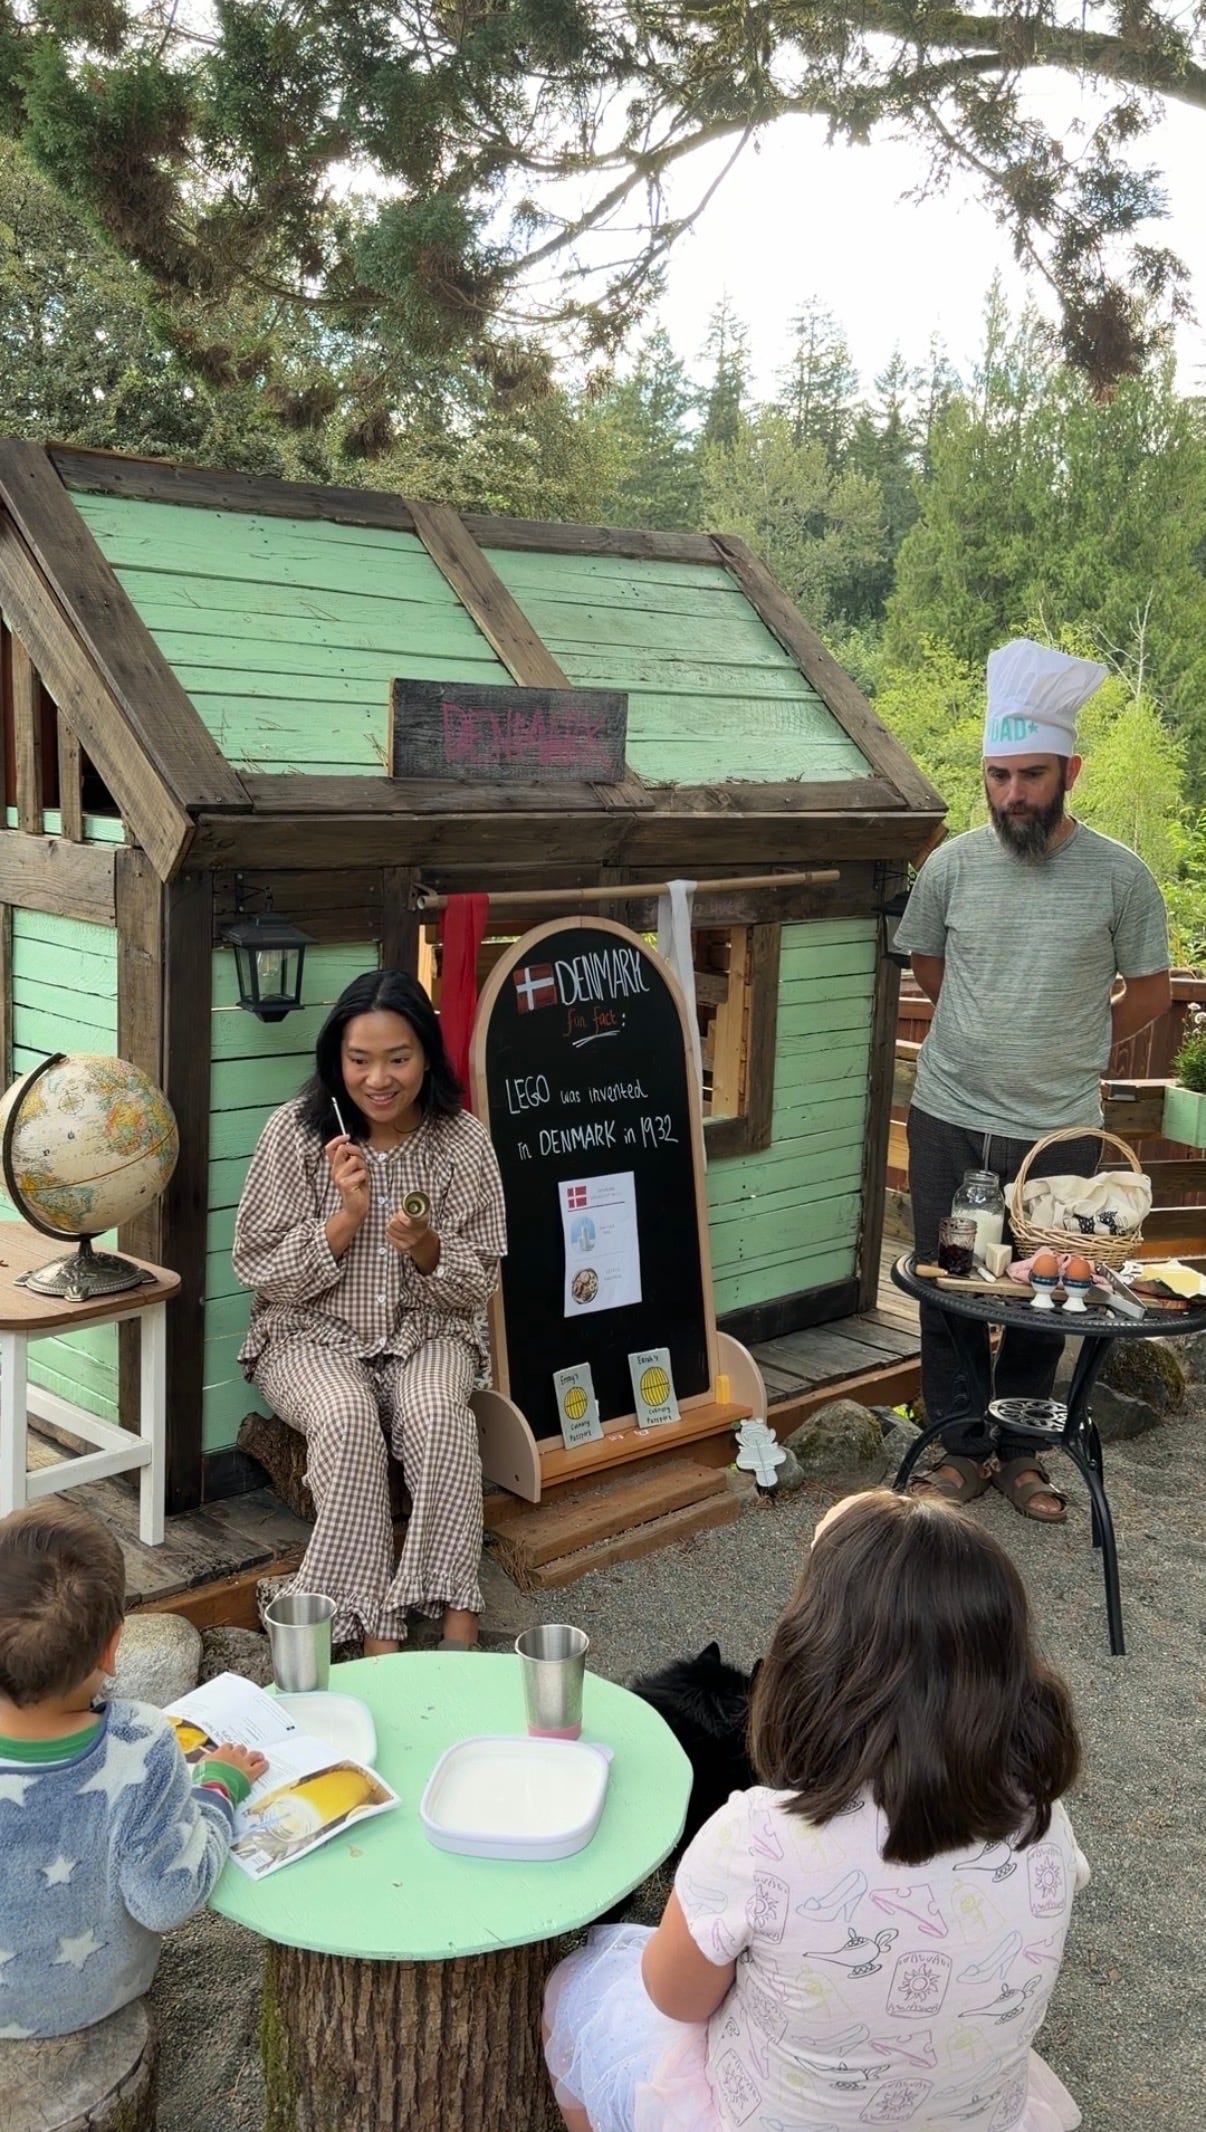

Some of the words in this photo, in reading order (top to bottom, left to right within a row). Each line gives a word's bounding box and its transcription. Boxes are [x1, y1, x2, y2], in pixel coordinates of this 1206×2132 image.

[554, 948, 650, 1005] DENMARK
[562, 1008, 586, 1037] fun
[505, 1074, 550, 1114] LEGO
[560, 1090, 581, 1104] was
[588, 1078, 648, 1104] invented
[539, 1120, 616, 1156] DENMARK
[624, 1126, 636, 1144] in
[640, 1114, 679, 1148] 1932
